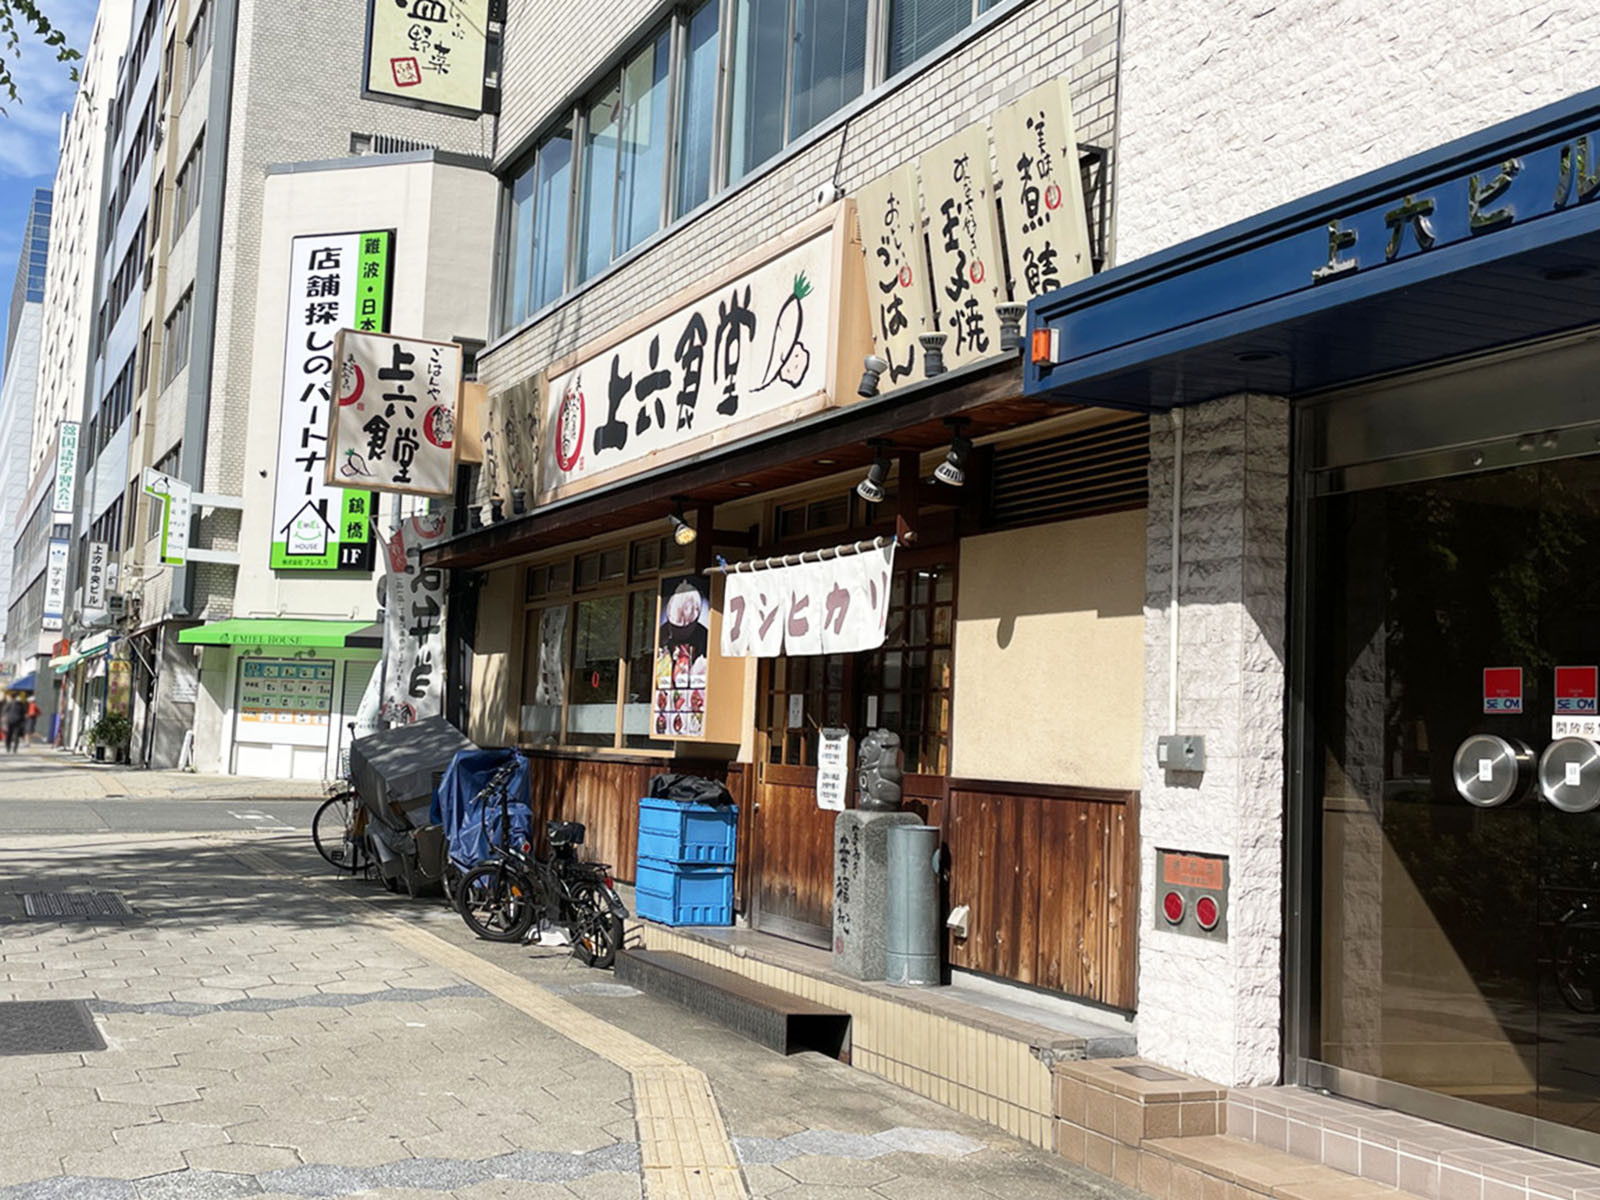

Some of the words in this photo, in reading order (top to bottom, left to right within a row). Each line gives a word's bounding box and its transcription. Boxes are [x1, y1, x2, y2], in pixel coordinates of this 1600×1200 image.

[877, 236, 914, 384] ごはん
[940, 197, 989, 355] 玉子焼
[362, 343, 420, 483] 上六食堂
[593, 284, 756, 456] 上六食堂
[342, 549, 361, 564] 1F
[347, 497, 364, 539] 鶴橋
[730, 571, 887, 642] コシヒカリ
